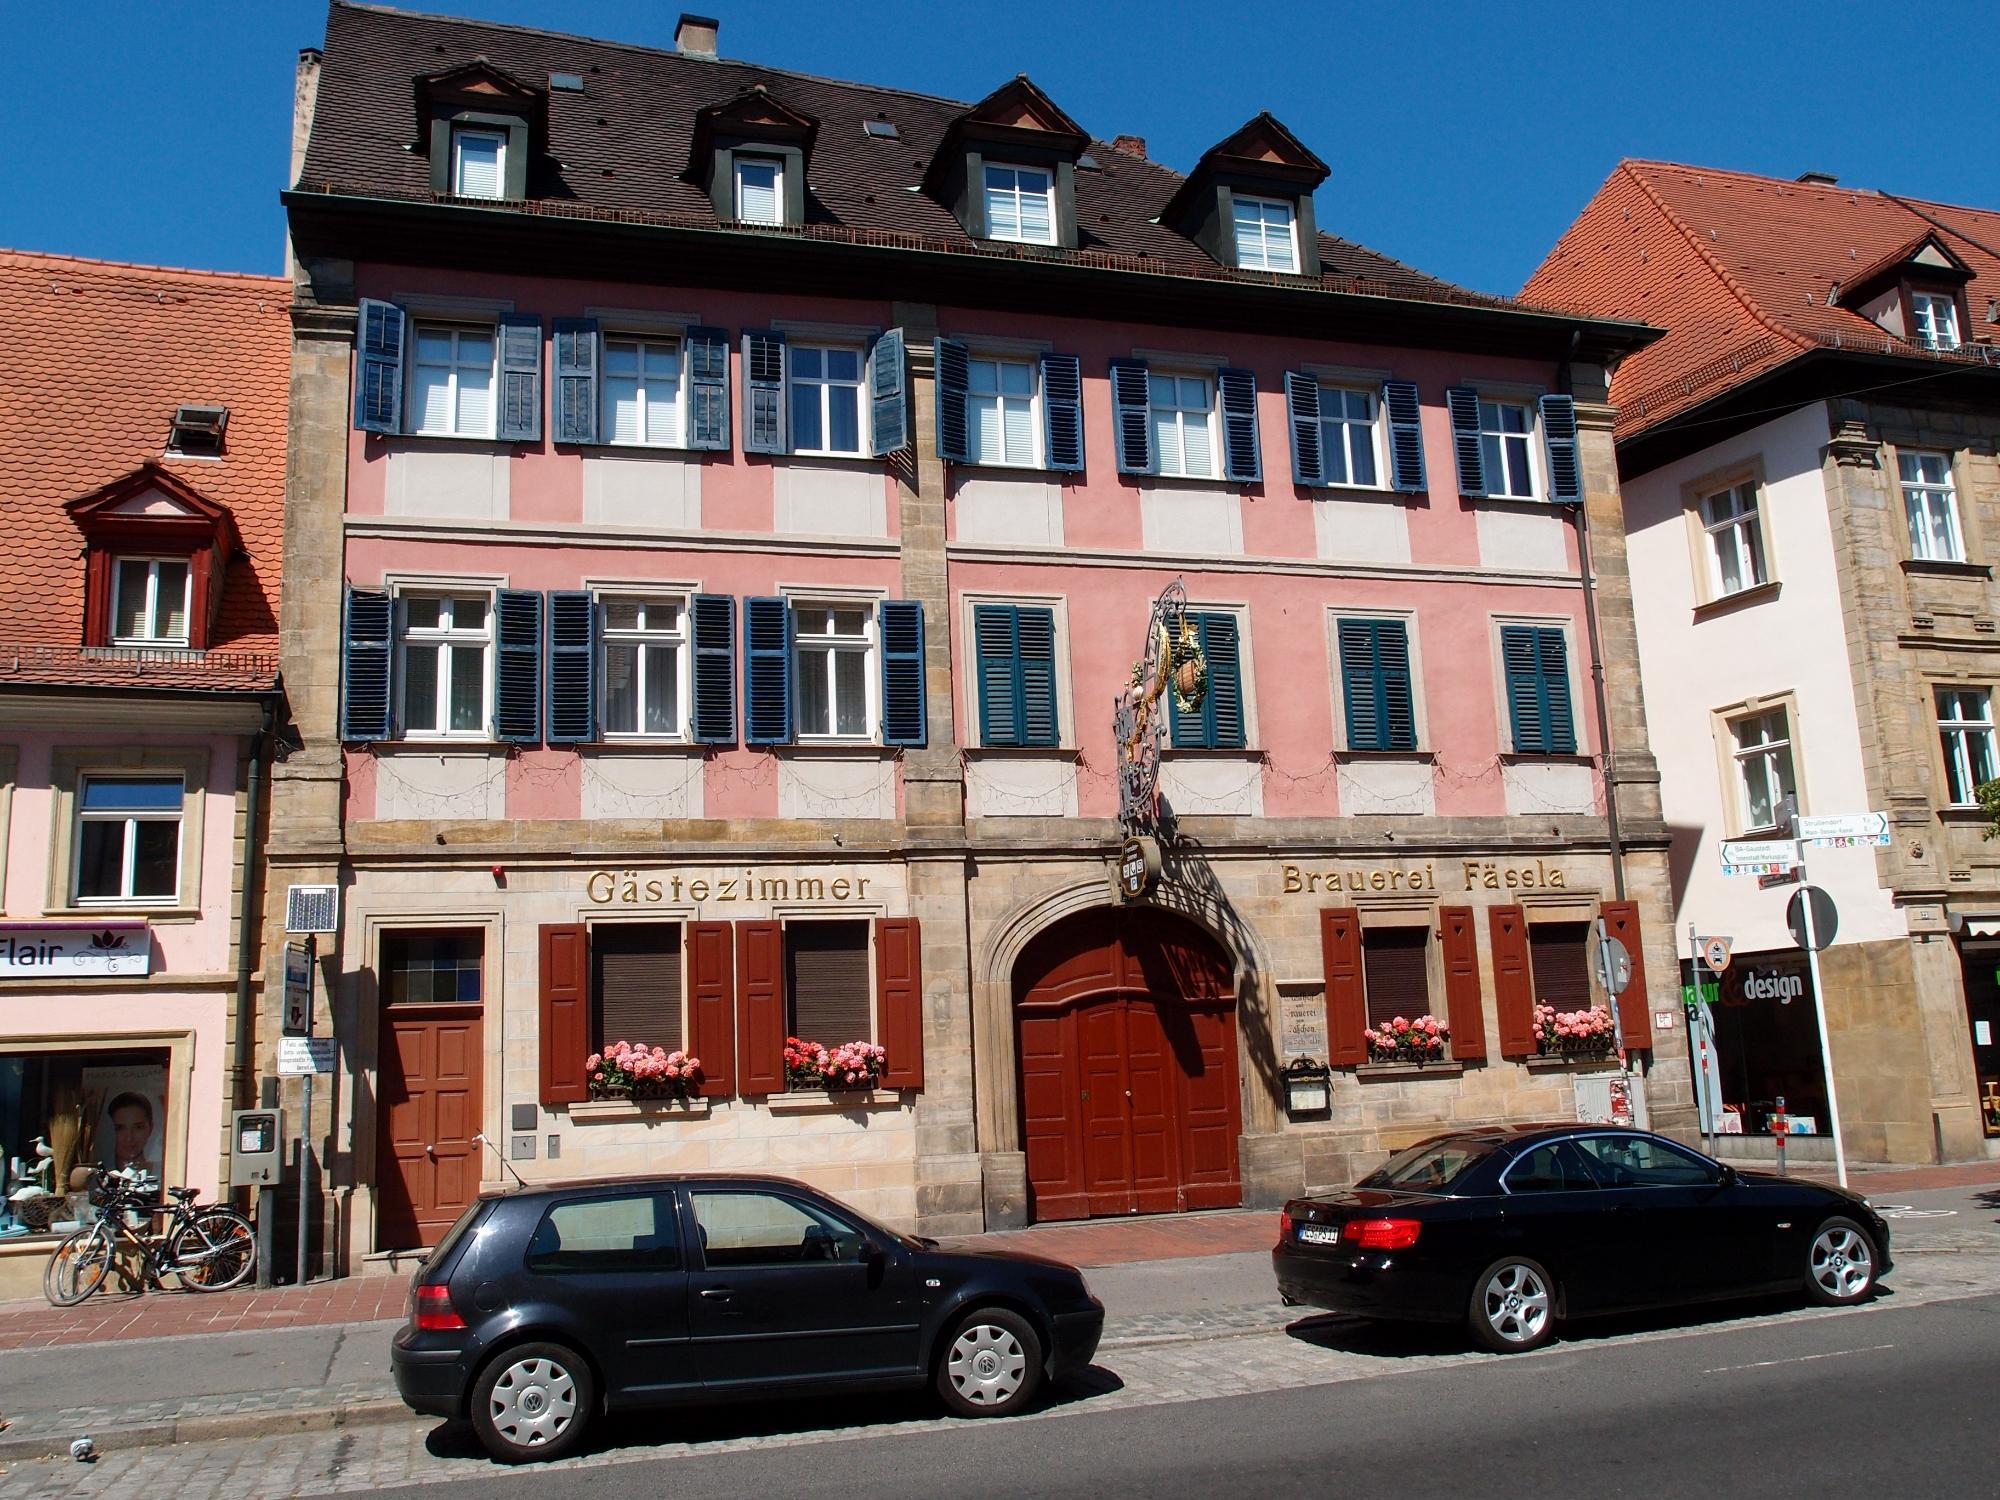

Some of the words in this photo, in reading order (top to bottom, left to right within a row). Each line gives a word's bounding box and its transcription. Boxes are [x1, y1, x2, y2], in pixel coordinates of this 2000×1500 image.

[587, 868, 871, 903] Gästezimmer
[1281, 864, 1436, 894] Brauerei
[1462, 859, 1566, 891] Fässla
[1681, 982, 1719, 1003] naur
[1744, 970, 1803, 1004] design
